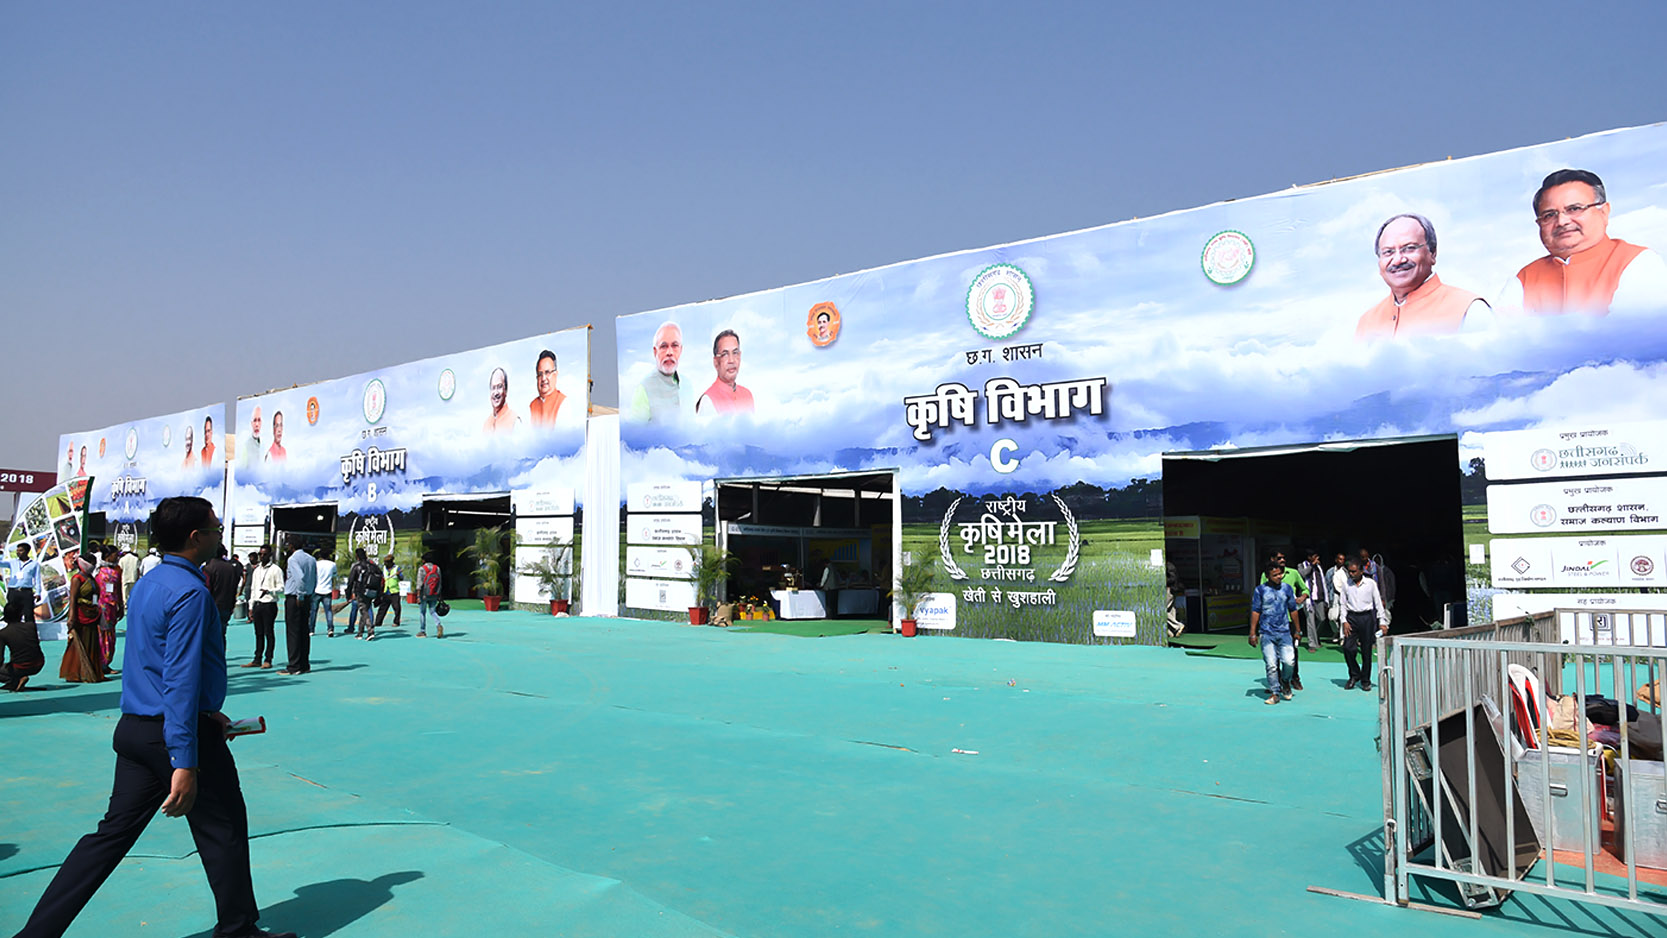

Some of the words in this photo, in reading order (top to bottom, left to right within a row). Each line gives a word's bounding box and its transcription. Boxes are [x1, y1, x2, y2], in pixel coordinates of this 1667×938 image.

[966, 349, 996, 365] छ.ग.
[1002, 343, 1043, 361] शासन
[904, 382, 979, 440] कृषि
[984, 377, 1107, 425] विभाग
[340, 448, 366, 483] कृषि
[367, 446, 407, 473] विभाग
[990, 438, 1019, 474] C
[0, 473, 34, 484] 2018
[367, 482, 377, 503] B
[985, 496, 1026, 516] राष्ट्रीय
[1630, 513, 1659, 524] विभाग
[984, 544, 1031, 565] 2018
[981, 564, 1035, 583] छत्तीसगढ़
[1561, 564, 1590, 573] JINDAL
[962, 585, 986, 603] खेती
[991, 585, 1002, 603] से
[1006, 587, 1056, 609] खुशहाली
